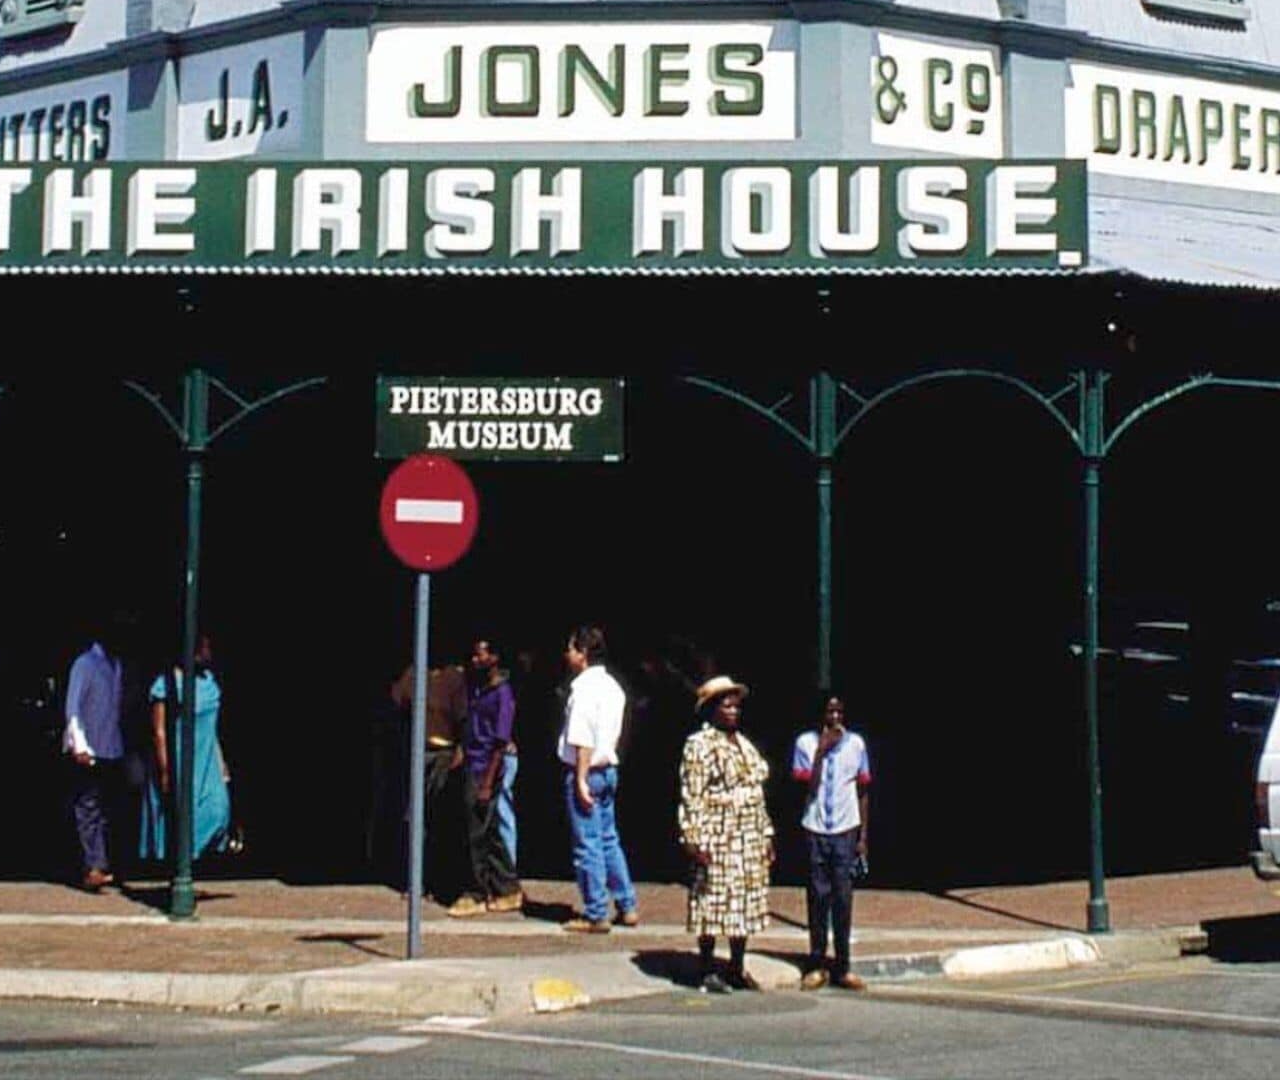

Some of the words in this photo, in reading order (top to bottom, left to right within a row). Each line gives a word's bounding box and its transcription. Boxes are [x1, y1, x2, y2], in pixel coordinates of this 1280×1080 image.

[205, 59, 288, 142] J.A.
[408, 42, 764, 118] JONES
[875, 56, 907, 125] &
[244, 167, 582, 258] IRISH
[632, 166, 1058, 258] HOUSE
[389, 386, 603, 416] PIETERSBURG
[427, 421, 573, 450] MUSEUM
